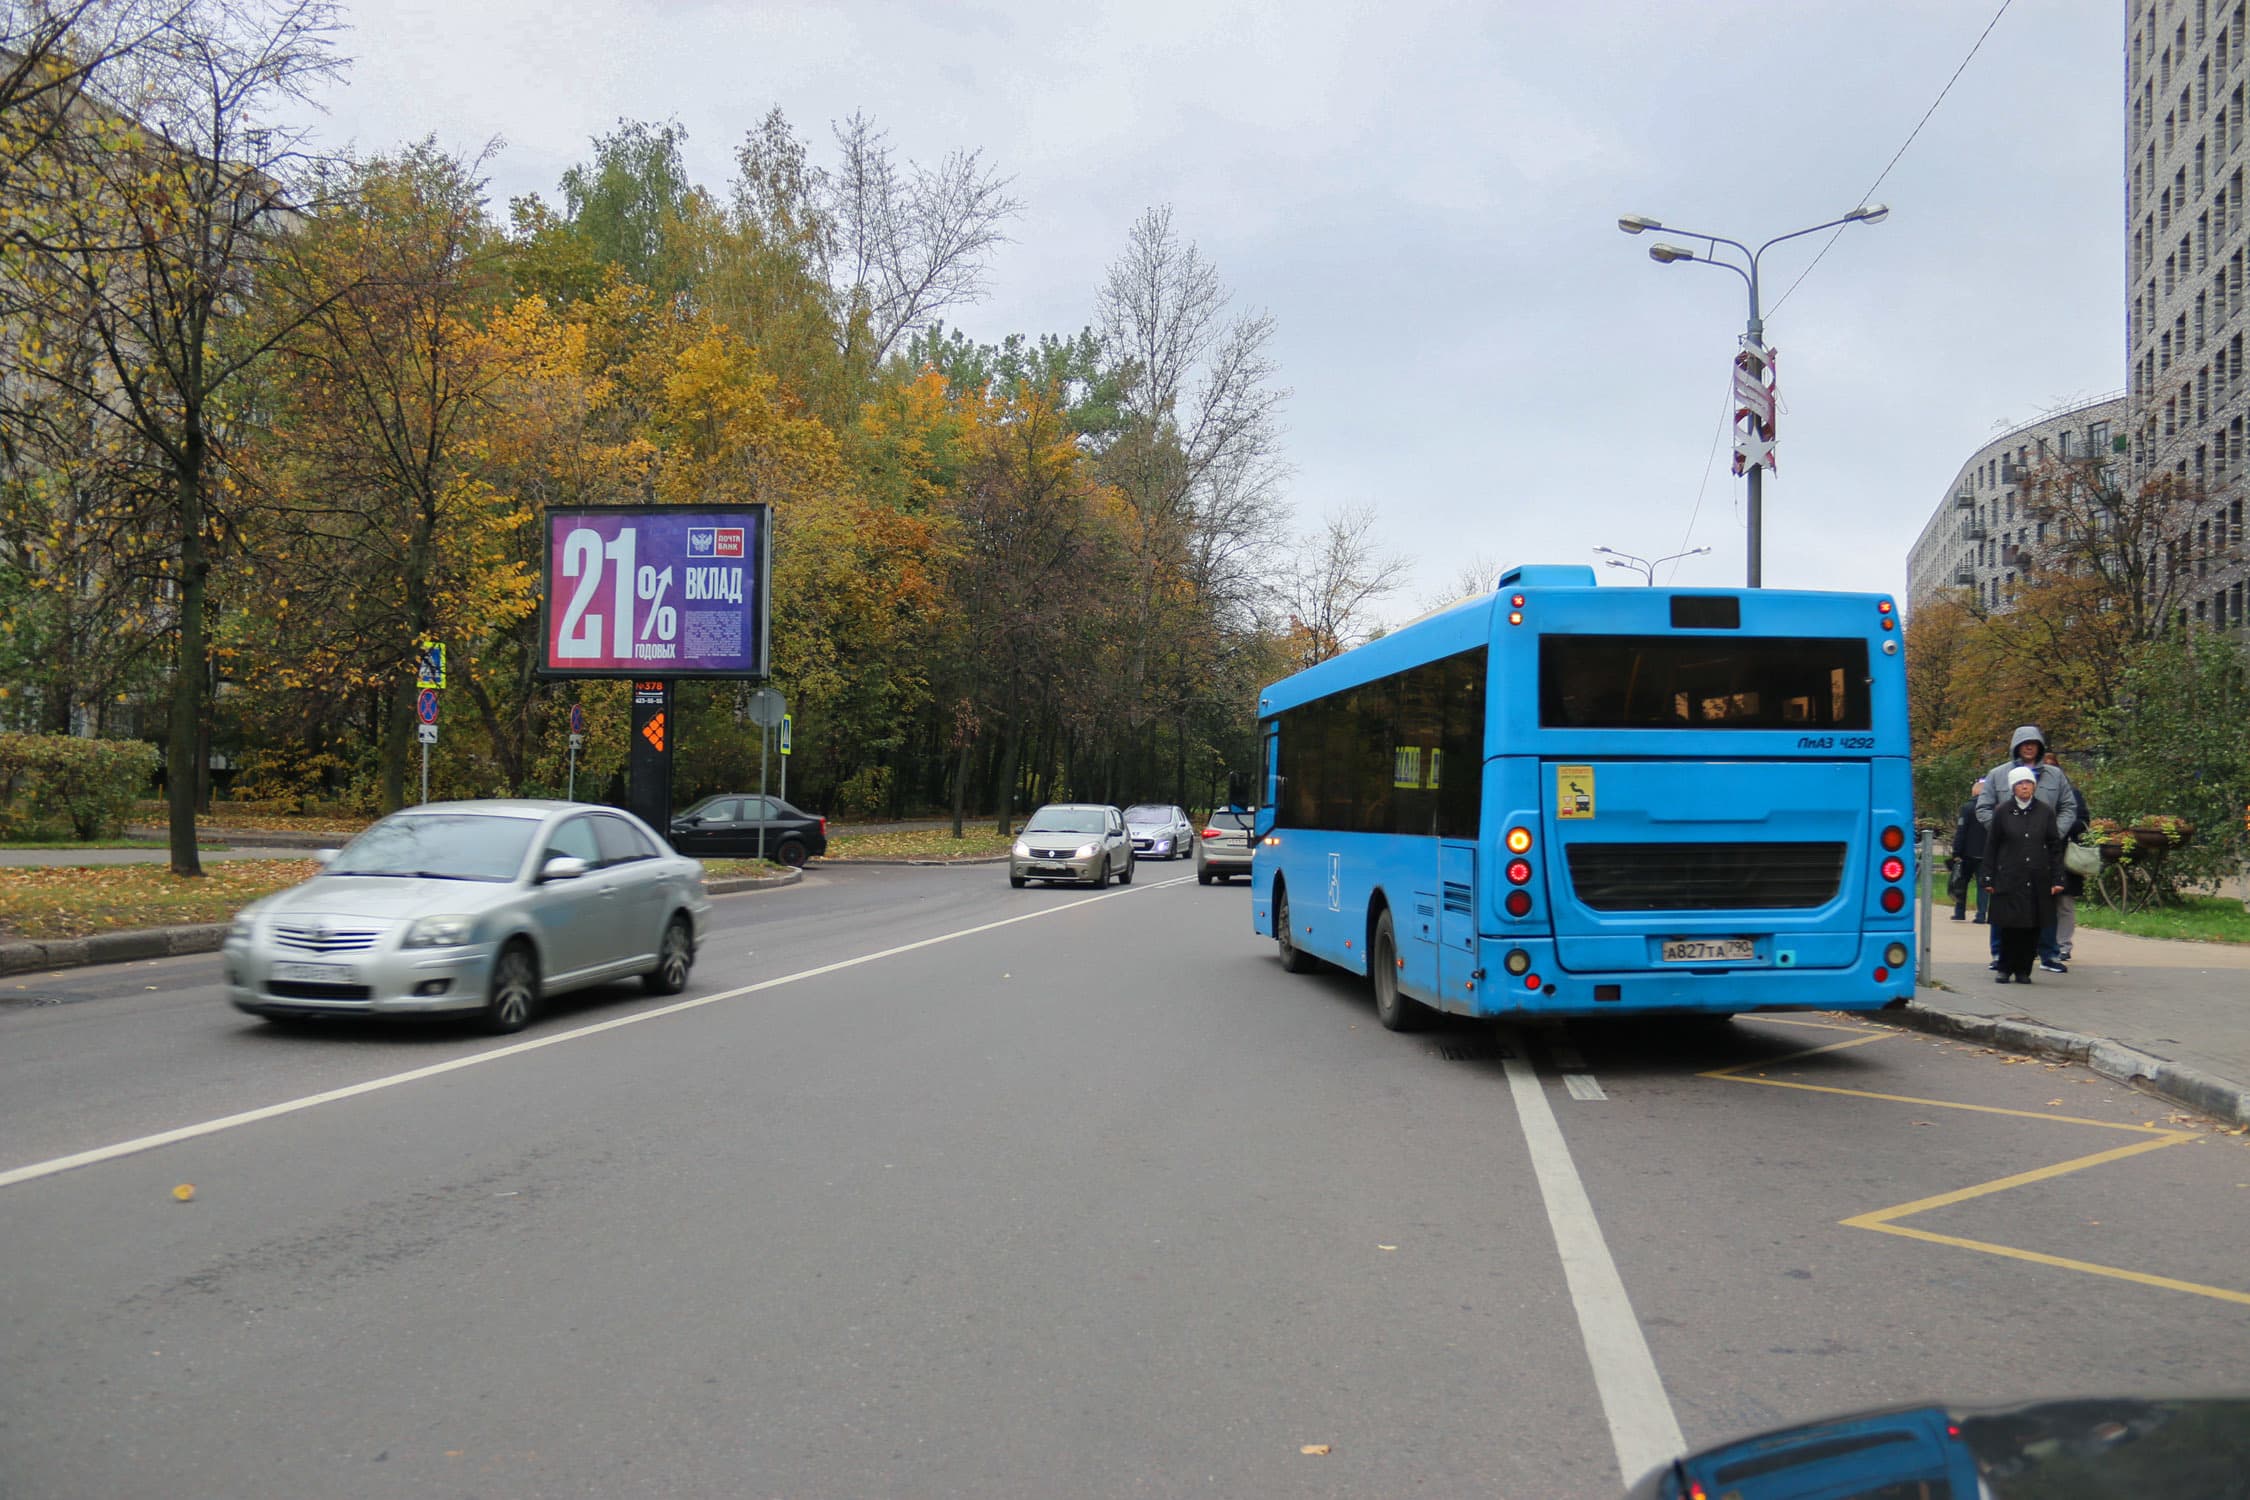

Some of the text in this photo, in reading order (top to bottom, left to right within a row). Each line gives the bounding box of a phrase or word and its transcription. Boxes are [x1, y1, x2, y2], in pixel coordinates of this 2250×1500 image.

[557, 527, 677, 659] 21%
[685, 567, 743, 604] ВКЛАД
[635, 643, 676, 660] ГОДОВЫХ
[1839, 736, 1875, 749] 4292
[1667, 943, 1726, 959] А827ТА
